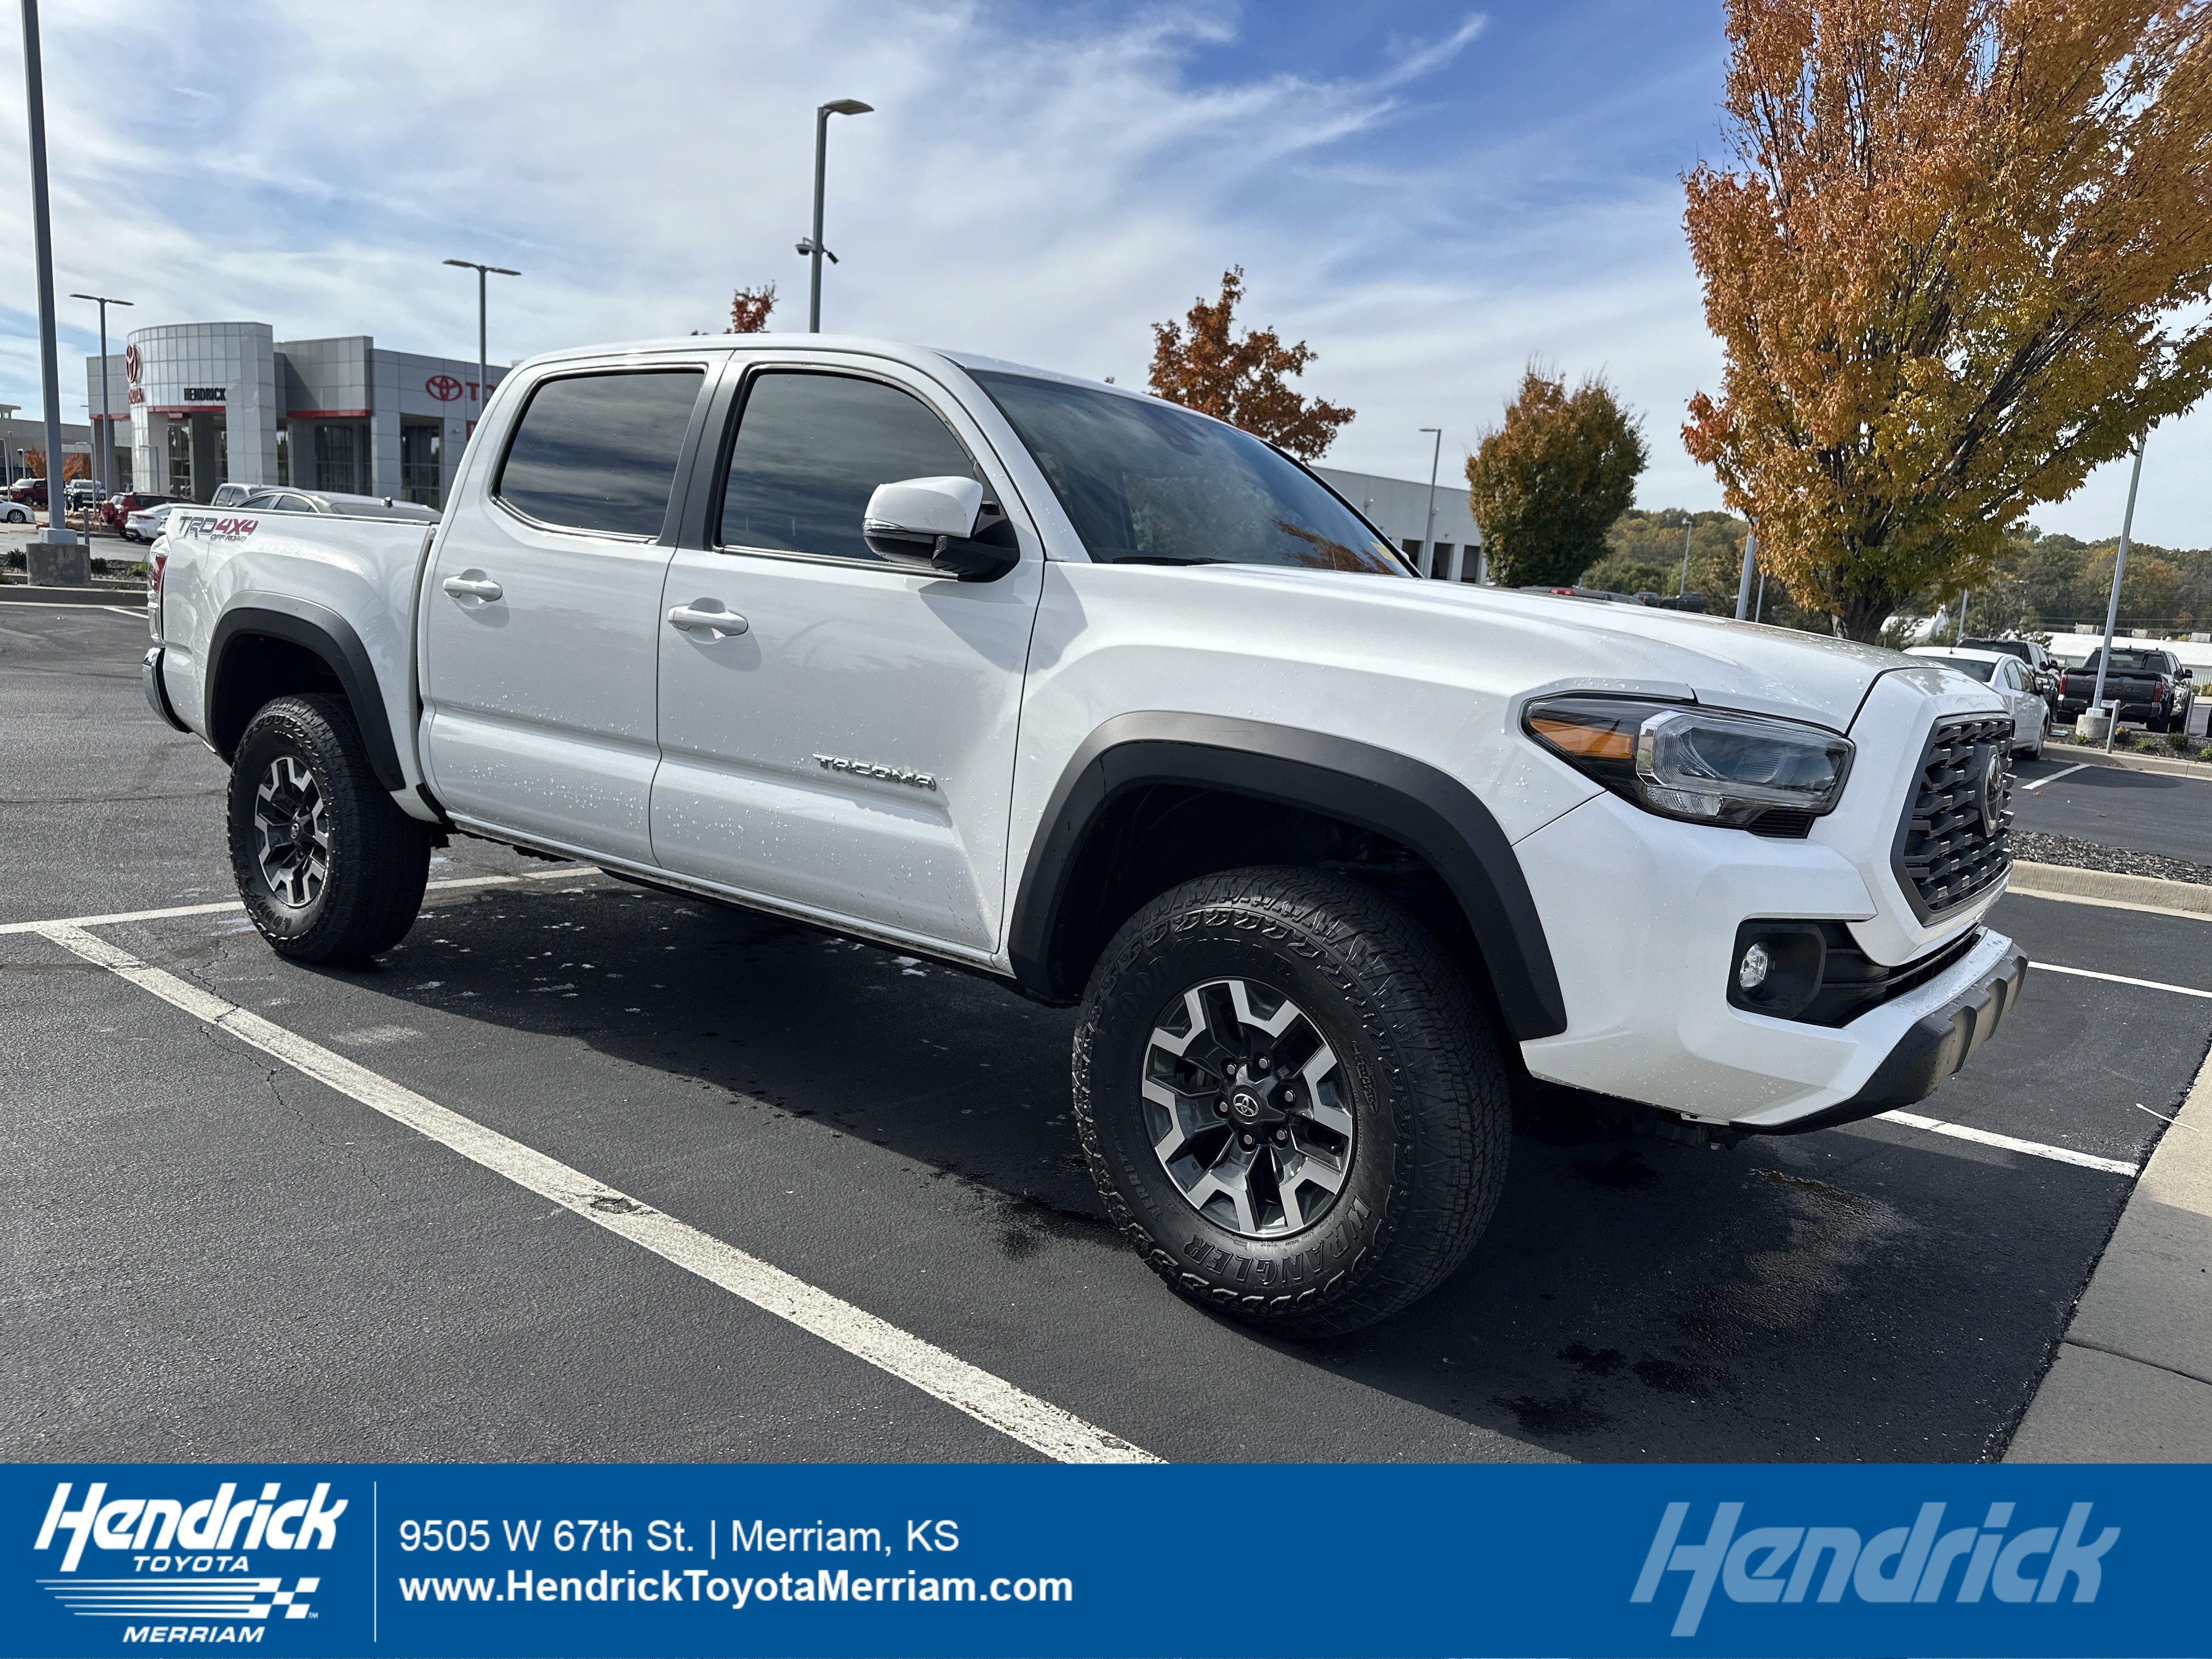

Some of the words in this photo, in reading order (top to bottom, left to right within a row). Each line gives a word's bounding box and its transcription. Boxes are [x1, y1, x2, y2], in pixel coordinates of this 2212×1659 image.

[184, 388, 227, 402] HENDRICK
[179, 516, 218, 540] TRD
[812, 753, 936, 792] TACOMA
[1183, 1194, 1371, 1285] WRANGLER
